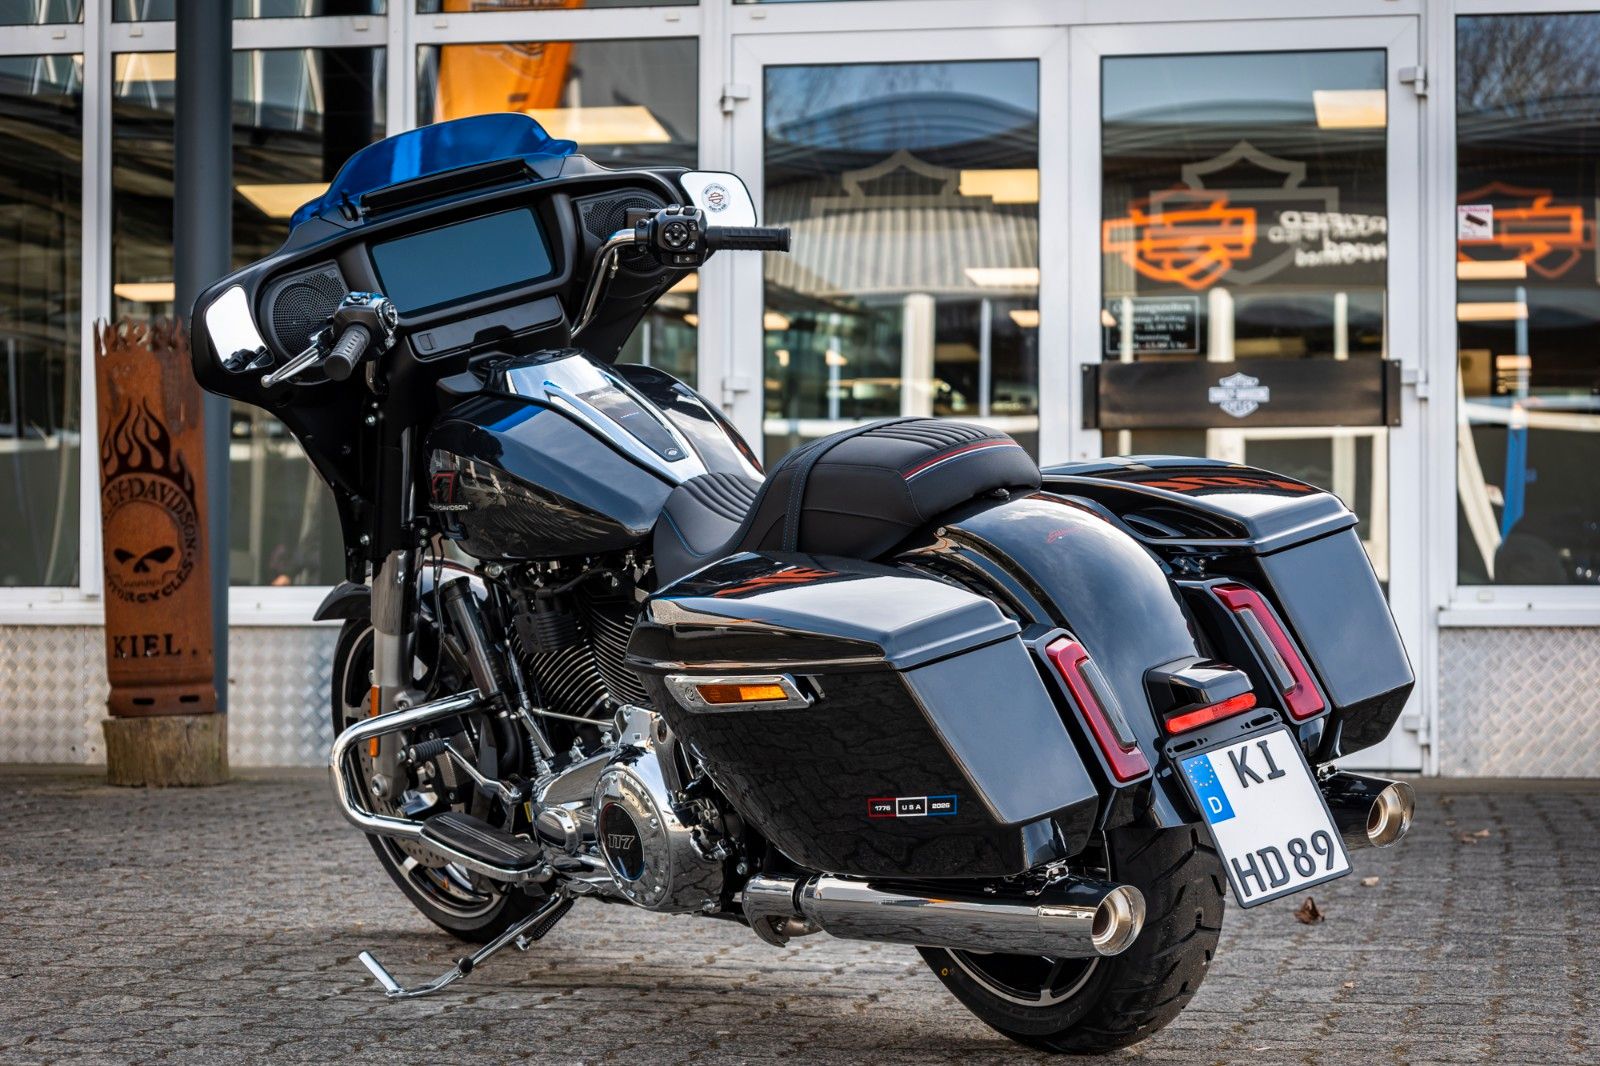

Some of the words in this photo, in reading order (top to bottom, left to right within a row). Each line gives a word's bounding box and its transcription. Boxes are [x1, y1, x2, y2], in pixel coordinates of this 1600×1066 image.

[1228, 740, 1286, 788] KI
[1208, 796, 1223, 814] D
[608, 833, 635, 850] 117
